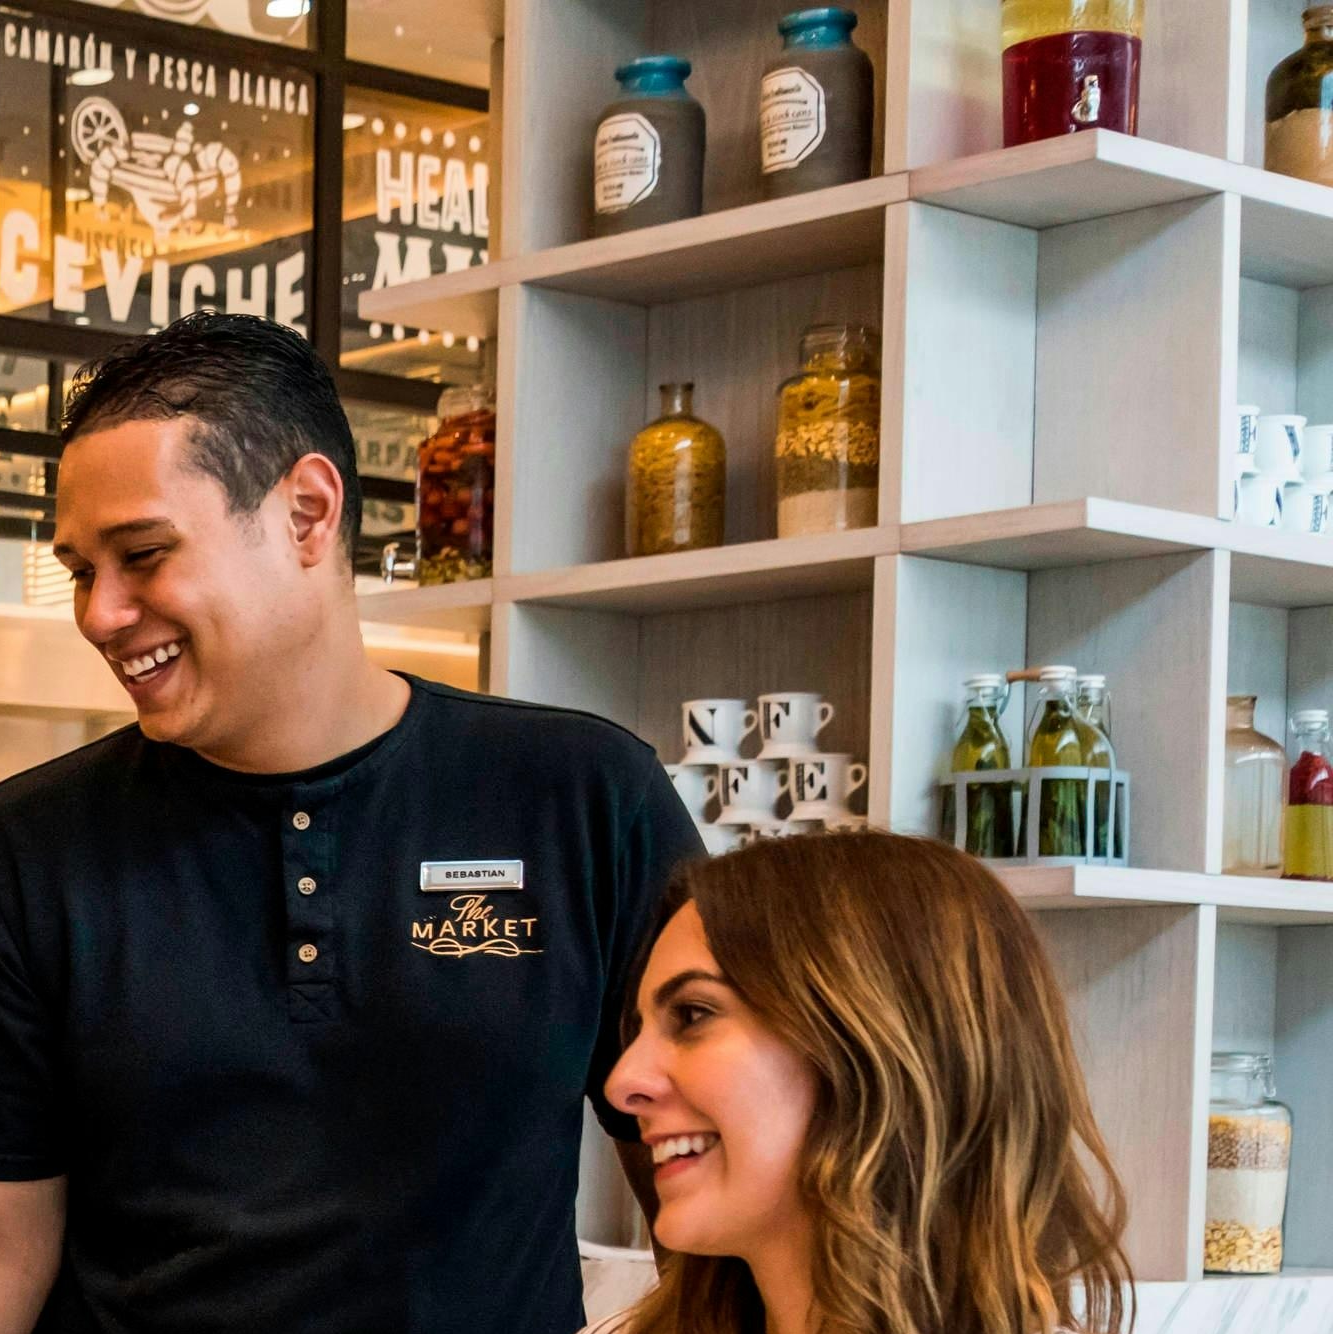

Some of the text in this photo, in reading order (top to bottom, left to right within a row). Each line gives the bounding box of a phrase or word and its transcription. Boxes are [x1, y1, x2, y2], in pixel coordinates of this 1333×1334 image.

[148, 52, 217, 98] PESCA
[228, 68, 309, 116] BLANCA
[0, 207, 308, 340] CEVICHE
[445, 870, 505, 879] SEBASTIAN
[450, 894, 494, 922] The
[411, 918, 538, 940] MARKET
